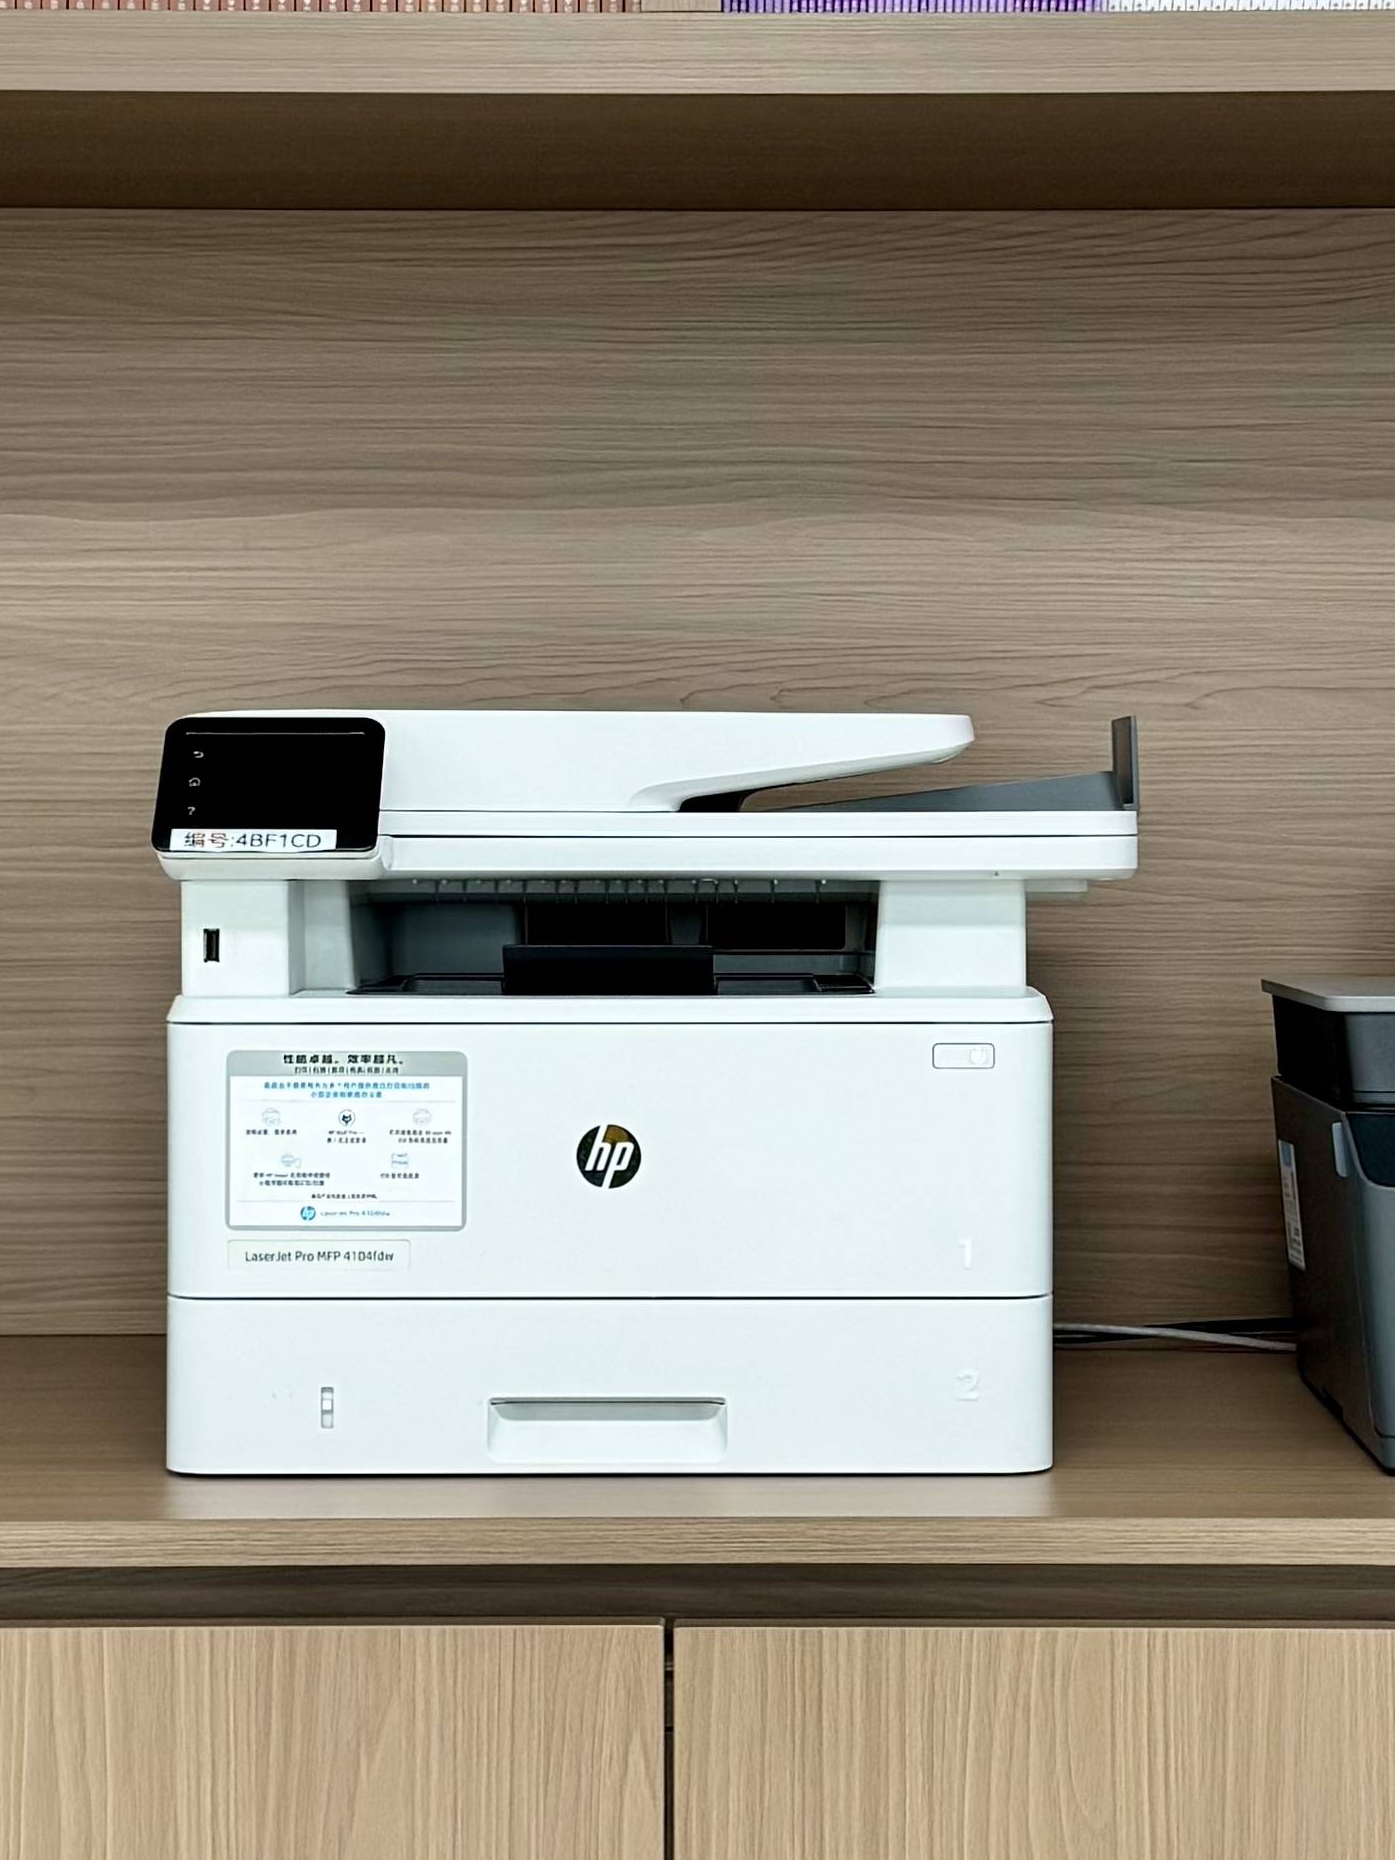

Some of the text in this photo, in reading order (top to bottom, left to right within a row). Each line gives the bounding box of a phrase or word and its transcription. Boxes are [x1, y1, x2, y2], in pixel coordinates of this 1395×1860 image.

[183, 831, 322, 849] 编号:4BF1CD
[585, 1124, 635, 1189] hp
[245, 1251, 394, 1262] LaserJet Pro MFP 4104fdw
